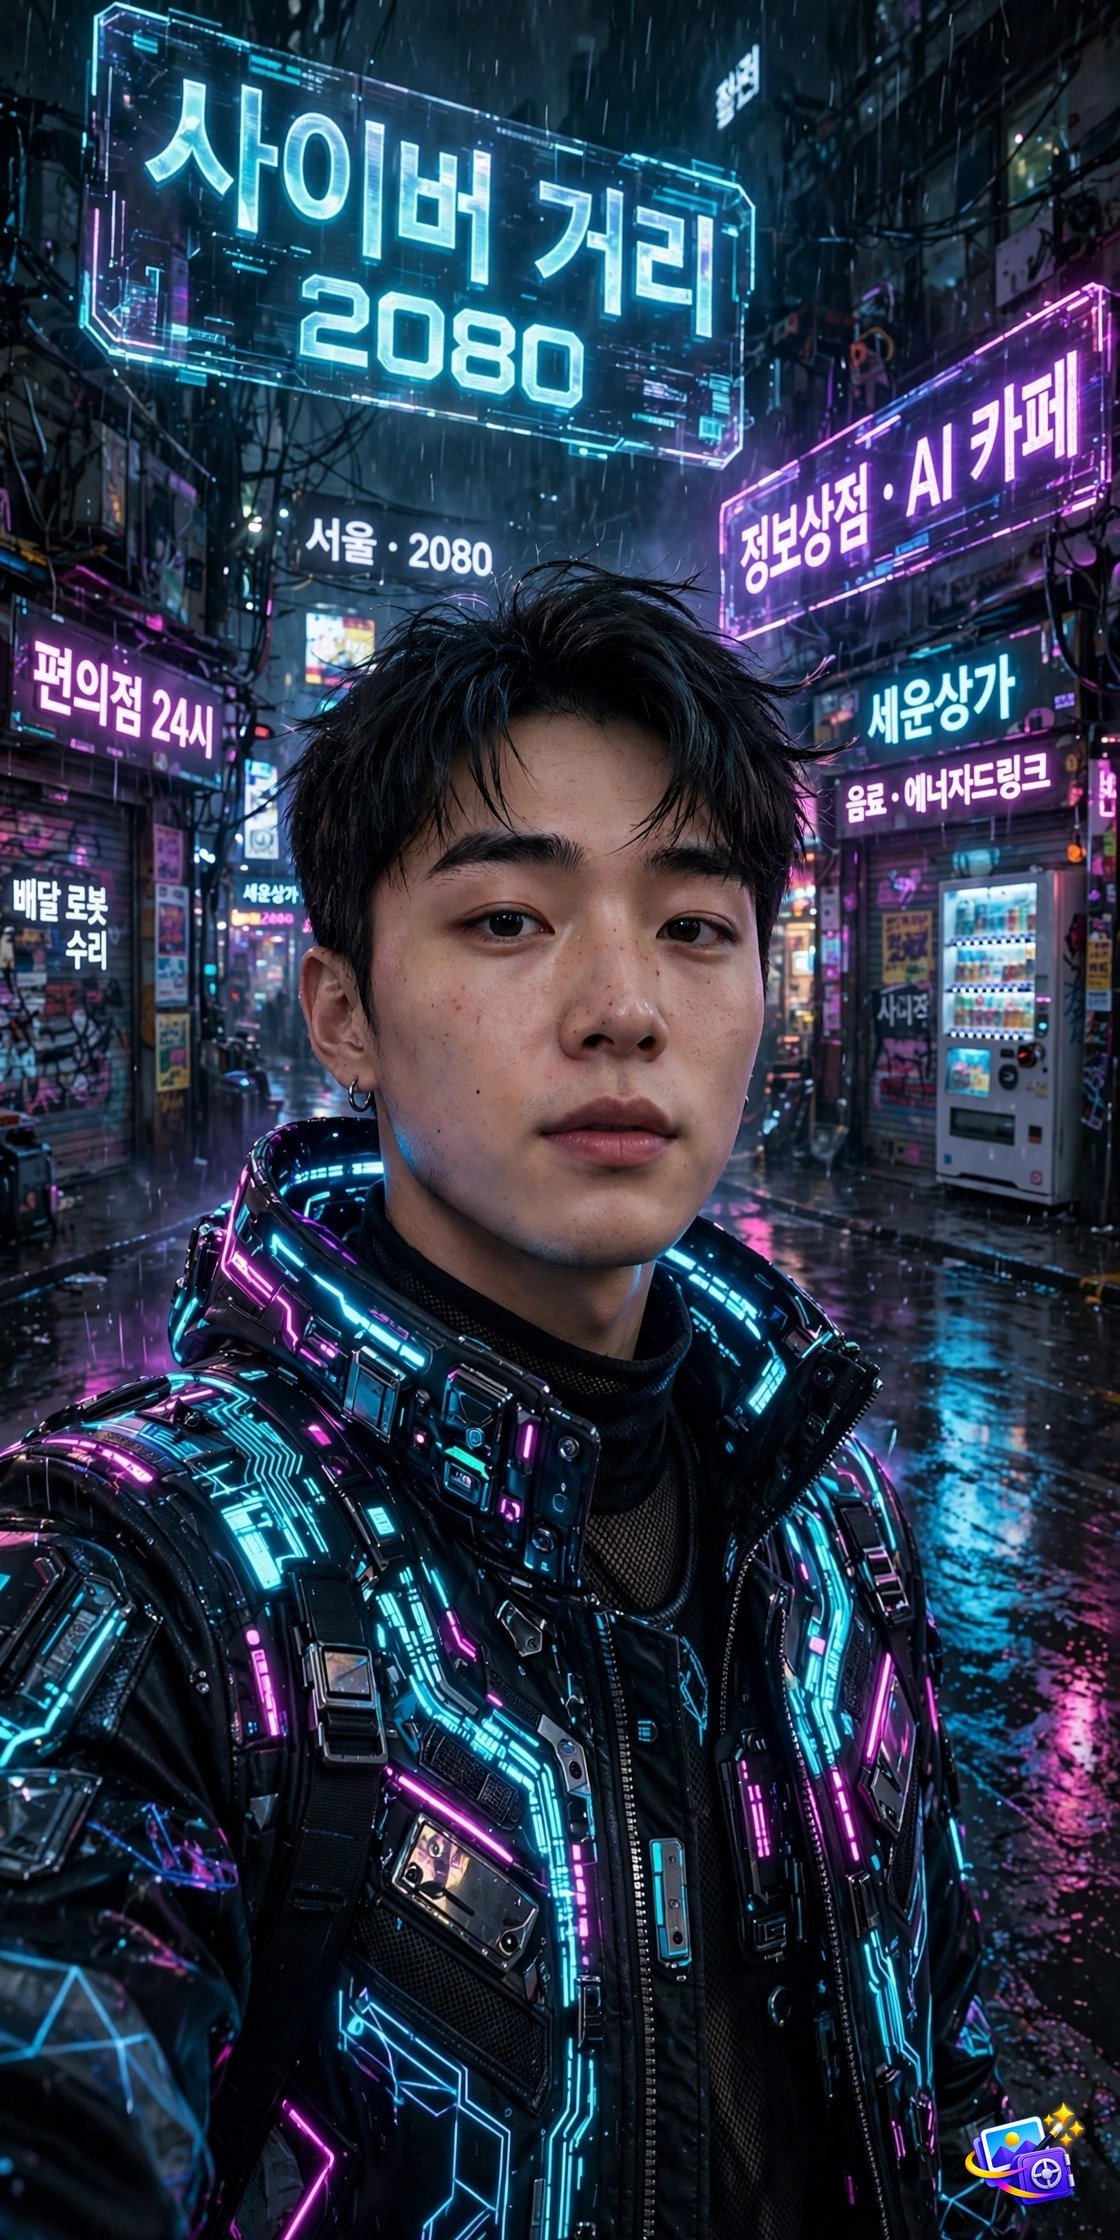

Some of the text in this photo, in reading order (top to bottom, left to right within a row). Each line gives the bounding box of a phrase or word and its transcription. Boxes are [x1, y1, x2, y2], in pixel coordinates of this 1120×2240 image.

[145, 78, 714, 340] 사이버 거리
[299, 273, 585, 409] 2080
[740, 462, 870, 595] 정보상점
[906, 422, 953, 518] AI
[970, 349, 1080, 483] 카페
[305, 517, 378, 566] 서울
[408, 532, 494, 578] 2080
[33, 640, 214, 760] 편의점 24시
[867, 653, 1016, 745] 세운상가
[845, 782, 887, 824] 음료
[904, 752, 1052, 814] 에너자드링크
[13, 877, 109, 926] 배달 로봇
[242, 882, 300, 905] 세운상가
[65, 929, 107, 971] 수리
